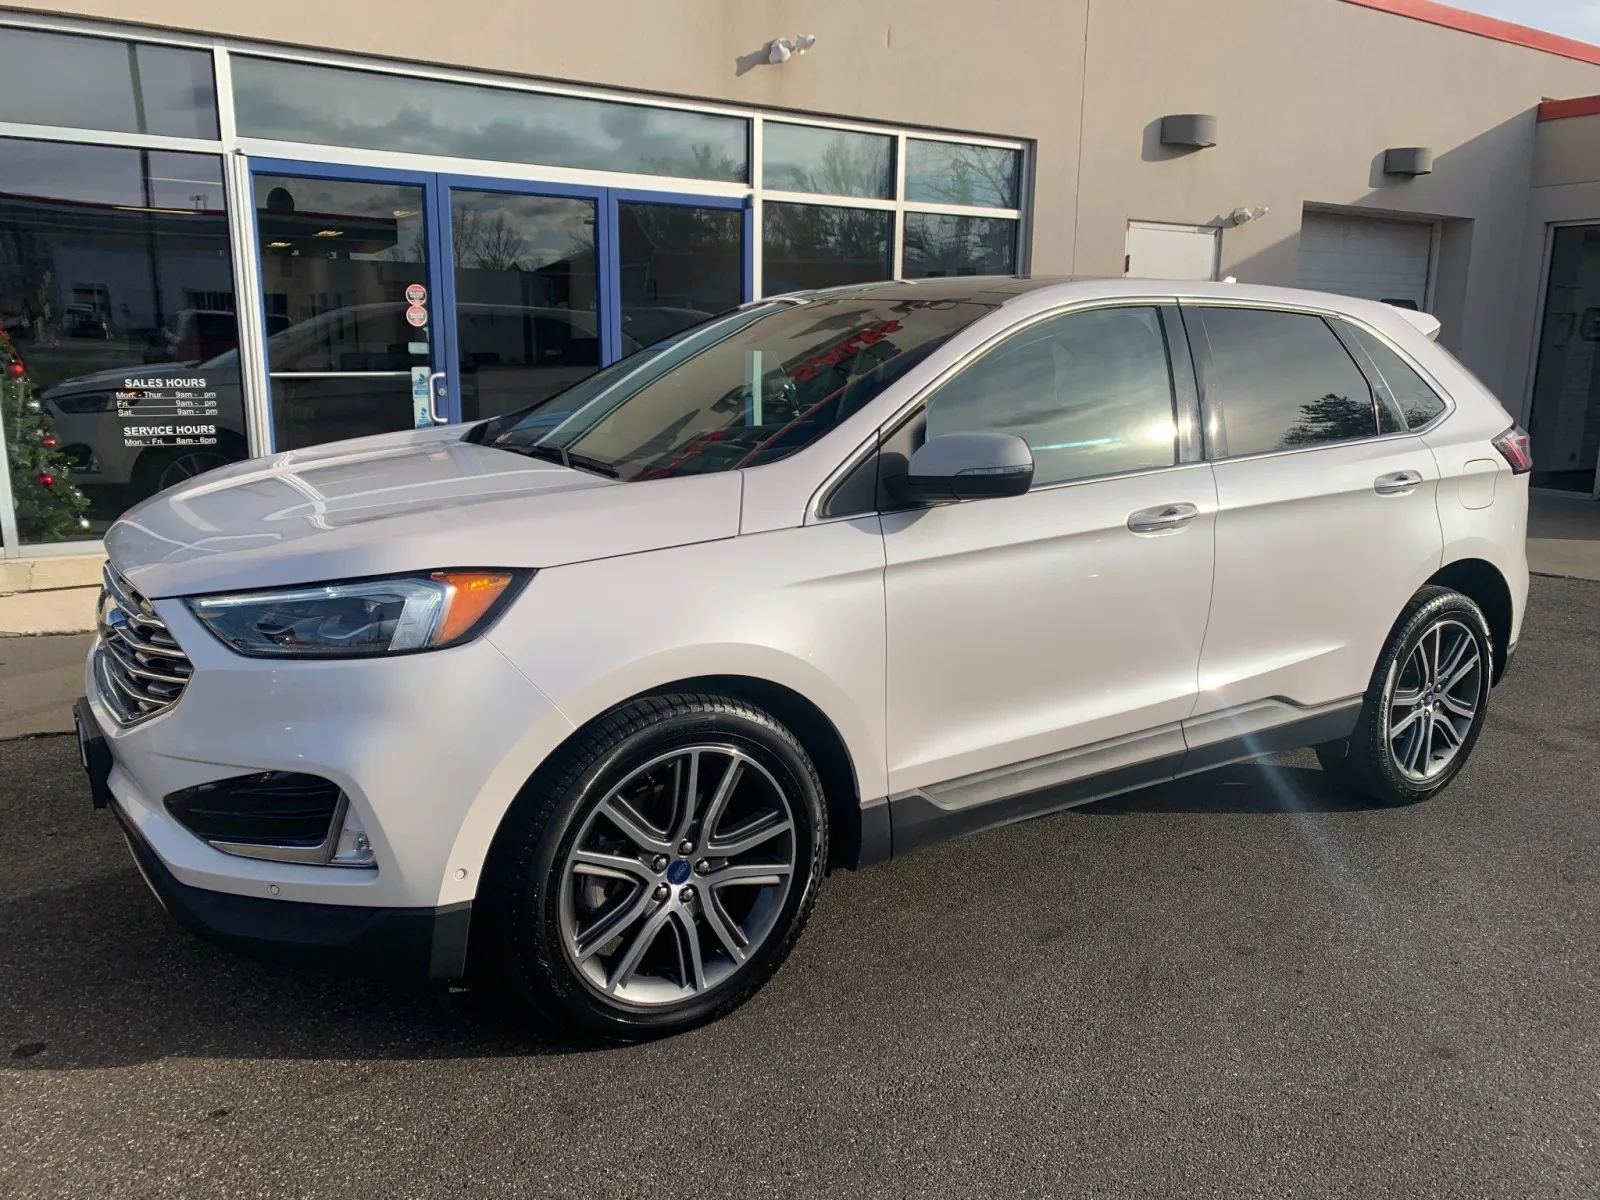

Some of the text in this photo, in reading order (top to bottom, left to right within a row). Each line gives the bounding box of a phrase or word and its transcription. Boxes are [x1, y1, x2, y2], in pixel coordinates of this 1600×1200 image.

[124, 378, 206, 388] SALES HOURS
[115, 391, 136, 399] Mon.
[143, 391, 164, 399] Thur.
[175, 391, 193, 399] 9am
[116, 400, 130, 408] Fri.
[175, 399, 194, 408] 9am
[117, 408, 134, 417] Sat.
[176, 408, 195, 416] 9am
[123, 425, 216, 436] SERVICE HOURS
[124, 439, 145, 447] Mon.
[151, 438, 165, 446] Fri.
[175, 437, 194, 446] 8am
[199, 437, 217, 445] 6pm
